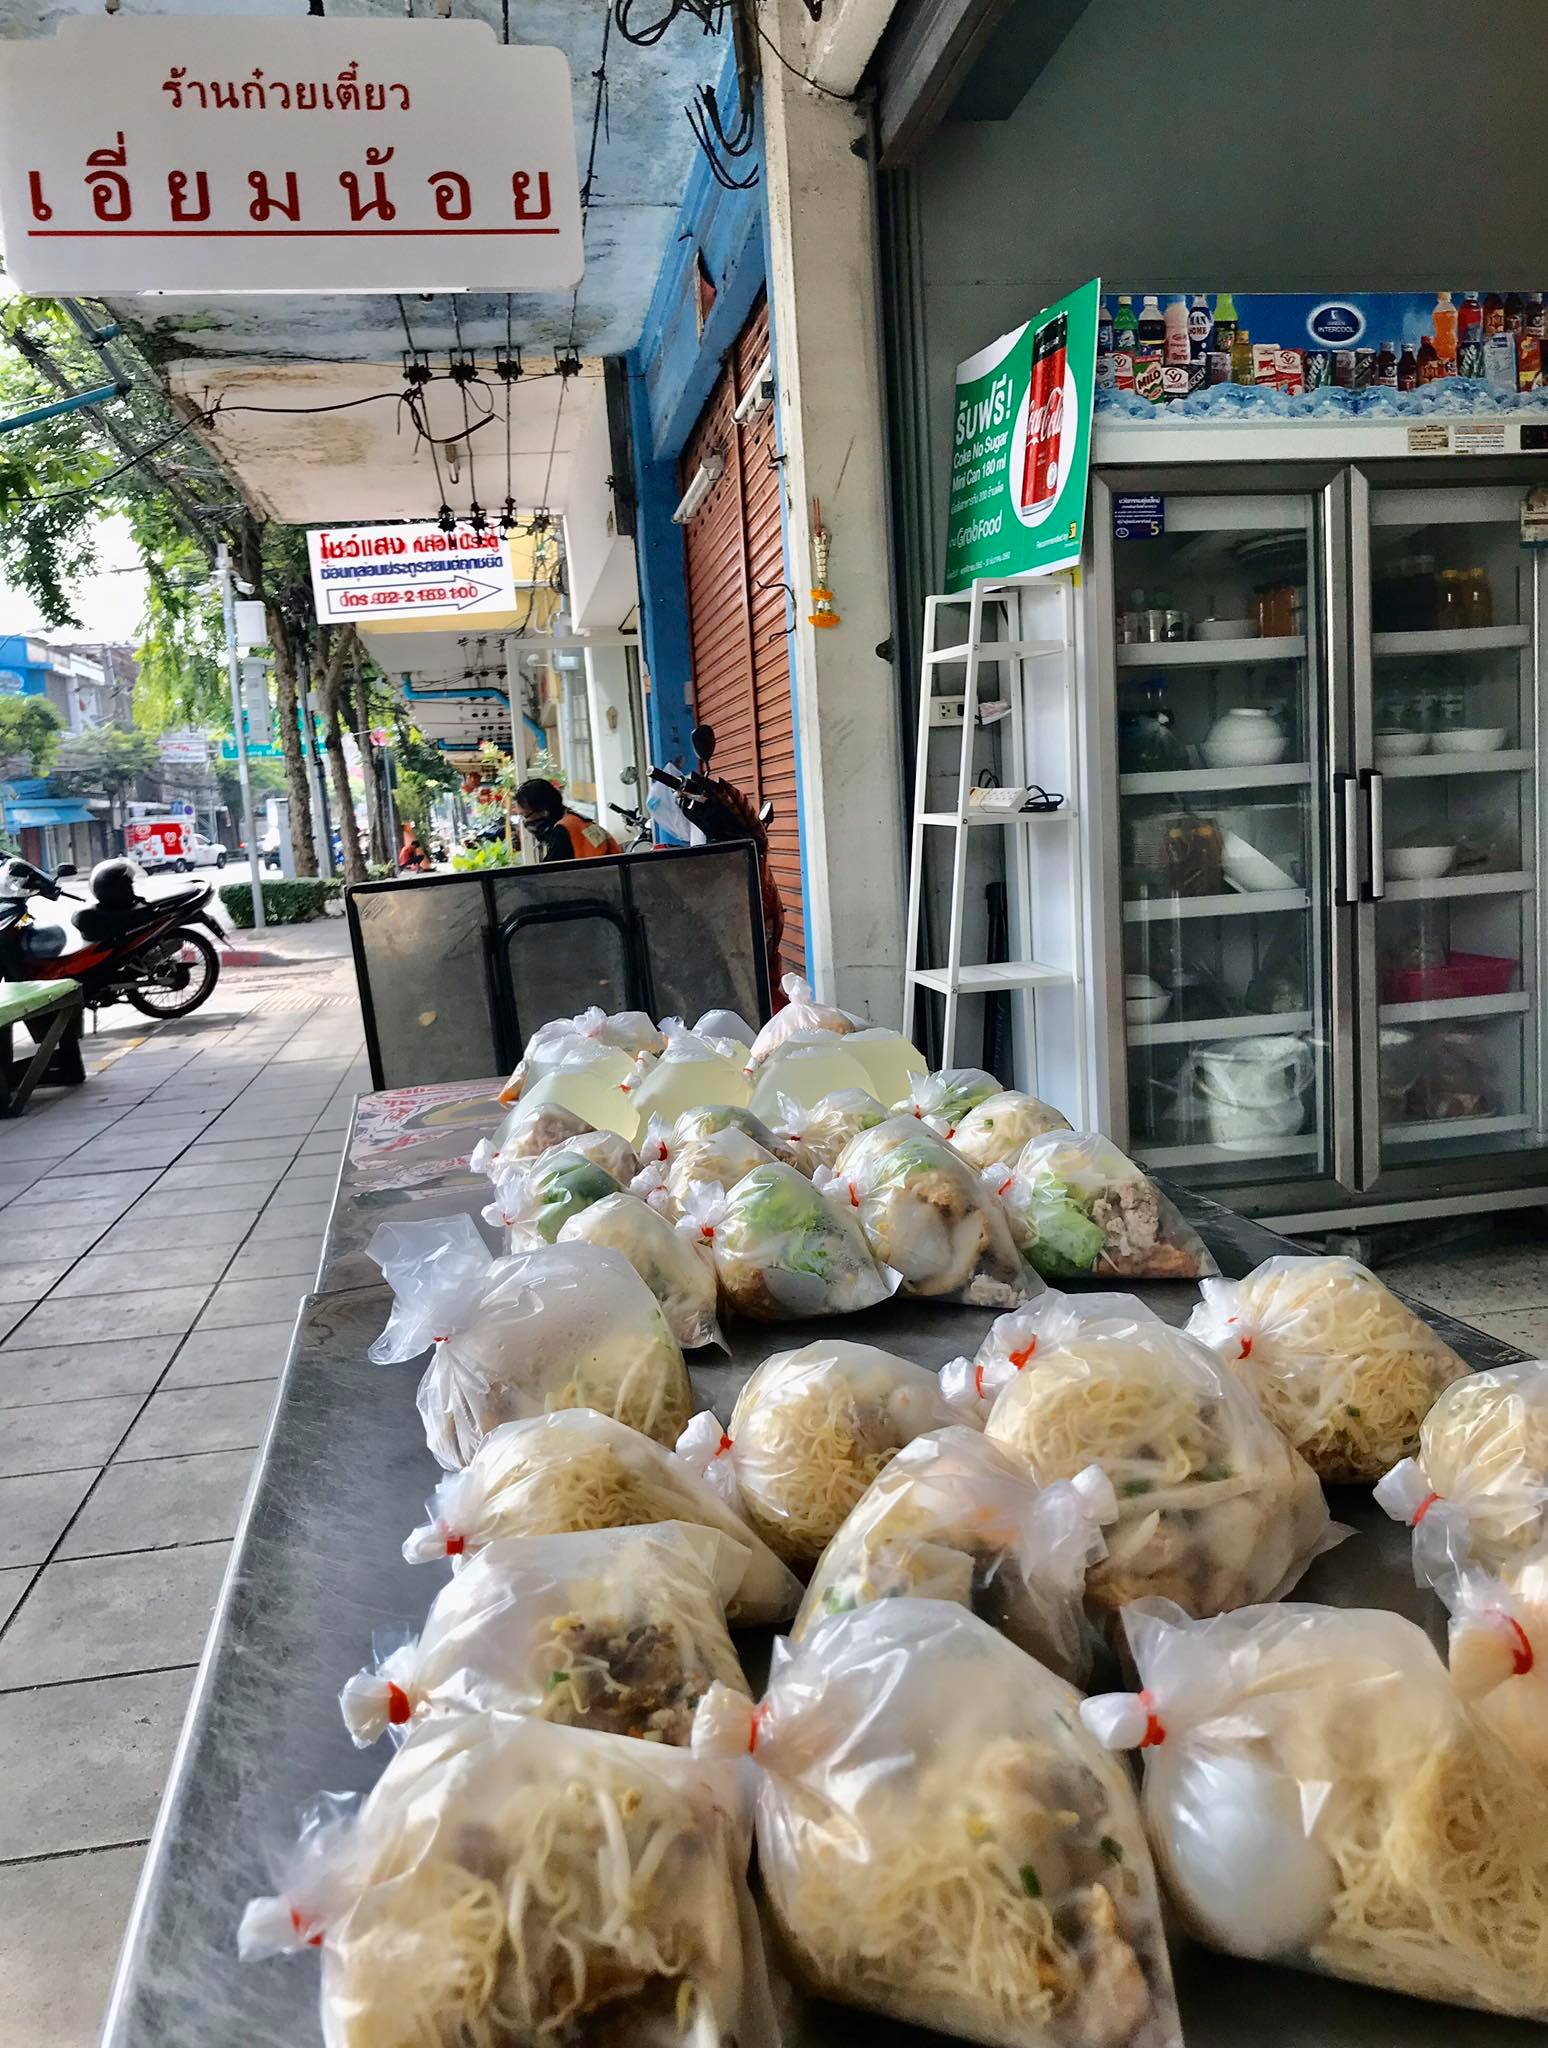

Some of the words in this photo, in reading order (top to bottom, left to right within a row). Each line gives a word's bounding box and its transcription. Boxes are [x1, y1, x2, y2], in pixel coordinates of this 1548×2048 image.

[162, 61, 411, 111] ร้านก๋วยเตี๋ยว
[1137, 369, 1161, 389] MILO
[954, 449, 972, 469] Coke
[972, 441, 984, 460] No
[984, 431, 1009, 454] Sugar
[952, 472, 966, 492] Mini
[966, 469, 981, 486] Can
[982, 458, 996, 478] 180
[996, 452, 1007, 472] ml
[956, 509, 1003, 549] GrabFood
